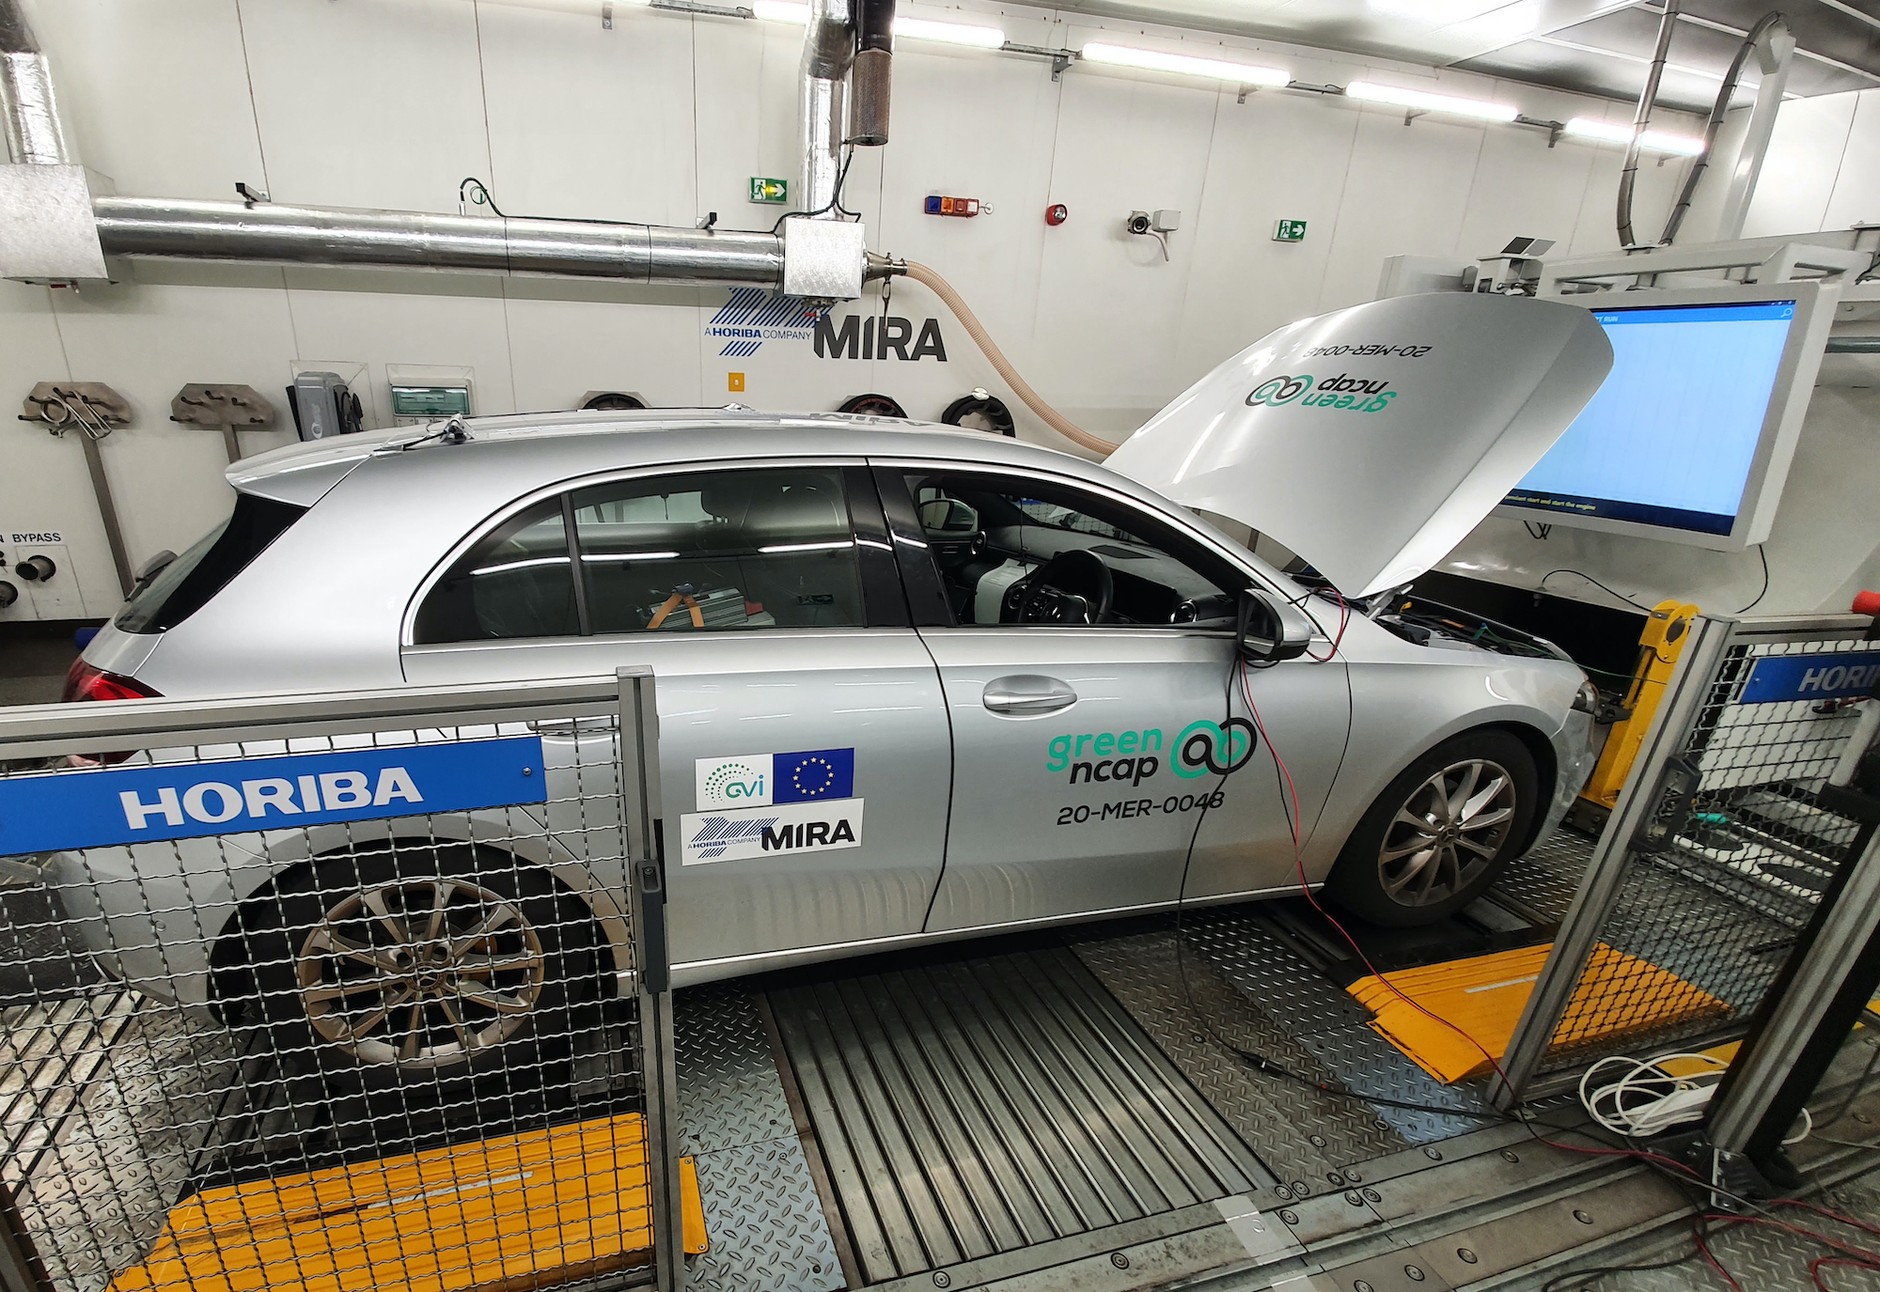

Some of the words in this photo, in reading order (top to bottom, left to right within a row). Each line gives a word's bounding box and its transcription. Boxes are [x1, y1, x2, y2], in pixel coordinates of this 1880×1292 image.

[704, 327, 712, 337] A
[712, 327, 762, 338] HORIBA
[763, 330, 812, 341] COMPANY
[813, 315, 948, 362] MIRA
[1303, 345, 1433, 358] 20-MER-0048
[1317, 373, 1390, 395] ncap
[1301, 391, 1398, 413] green
[12, 532, 62, 543] BYPASS
[1798, 665, 1880, 692] HORI
[1046, 728, 1163, 772] green
[1069, 756, 1159, 787] ncap
[119, 767, 424, 829] HORIBA
[1057, 791, 1225, 825] 20-MER-0048
[692, 840, 727, 849] HORIBA
[727, 836, 761, 846] COMPANY
[761, 819, 856, 851] MIRA
